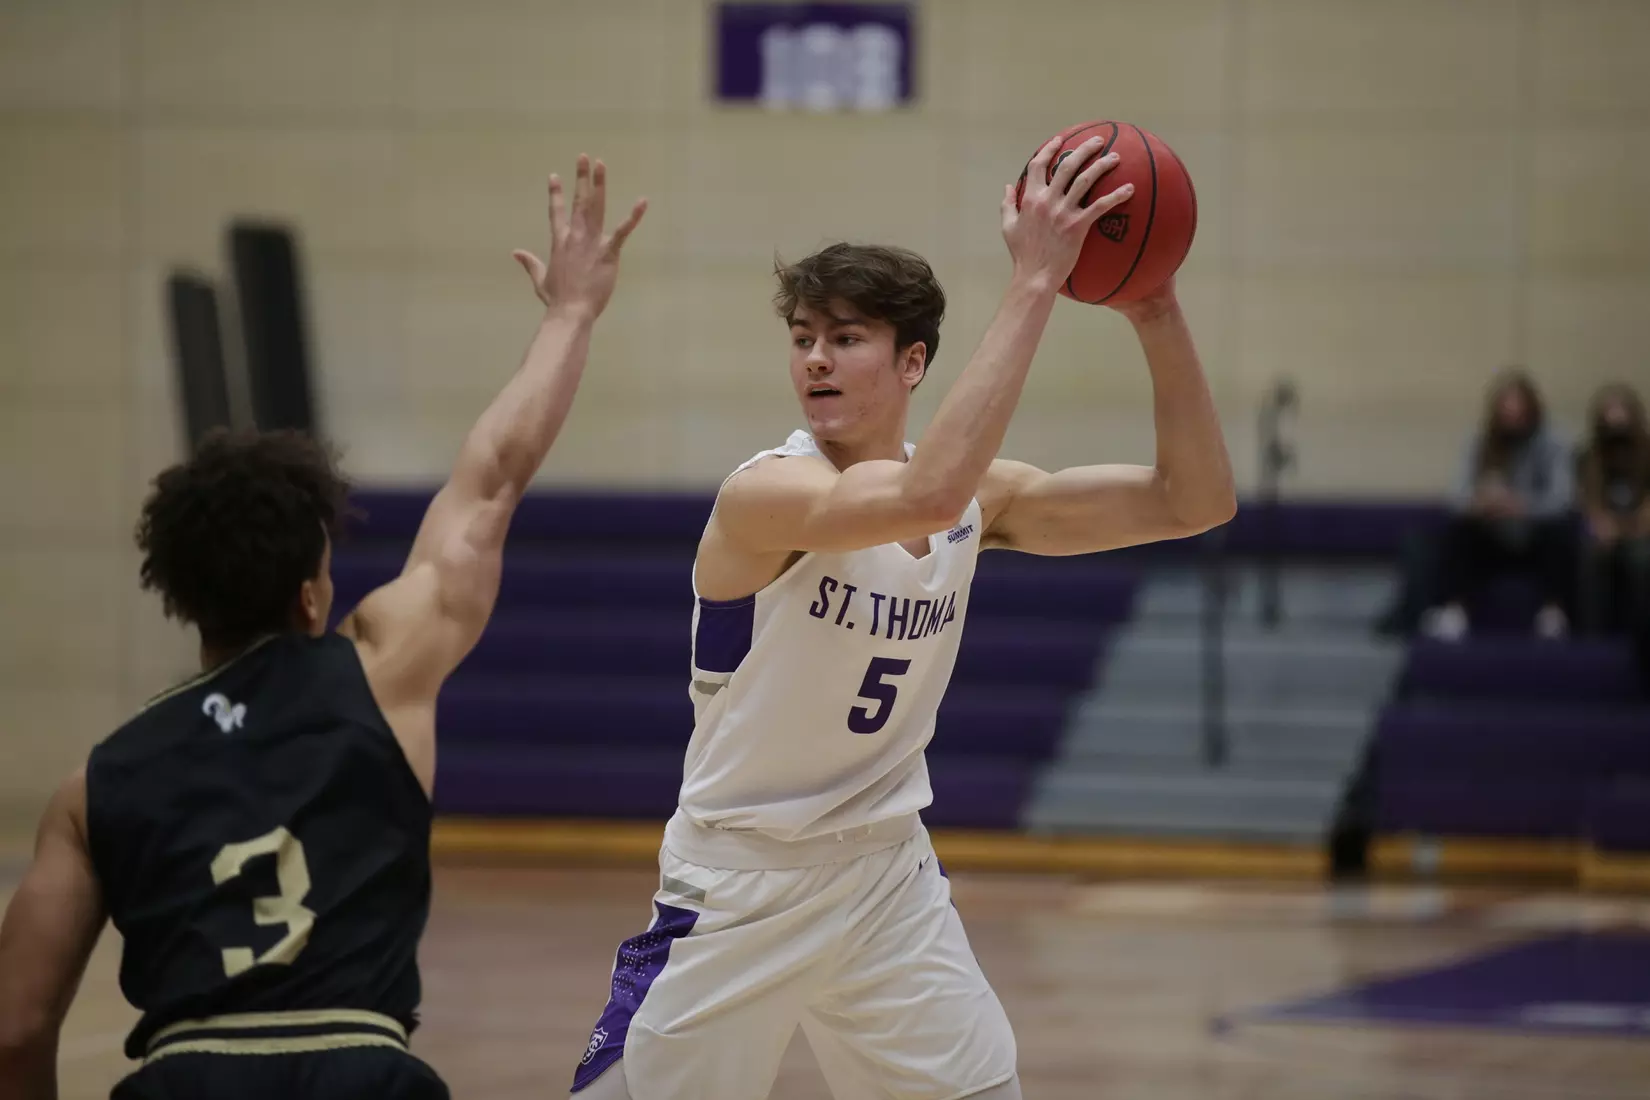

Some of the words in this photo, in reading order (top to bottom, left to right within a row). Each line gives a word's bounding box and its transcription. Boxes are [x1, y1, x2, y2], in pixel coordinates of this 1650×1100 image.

[947, 524, 974, 544] SUMMIT
[809, 576, 857, 629] ST.
[847, 656, 911, 735] 5
[210, 826, 317, 977] 3
